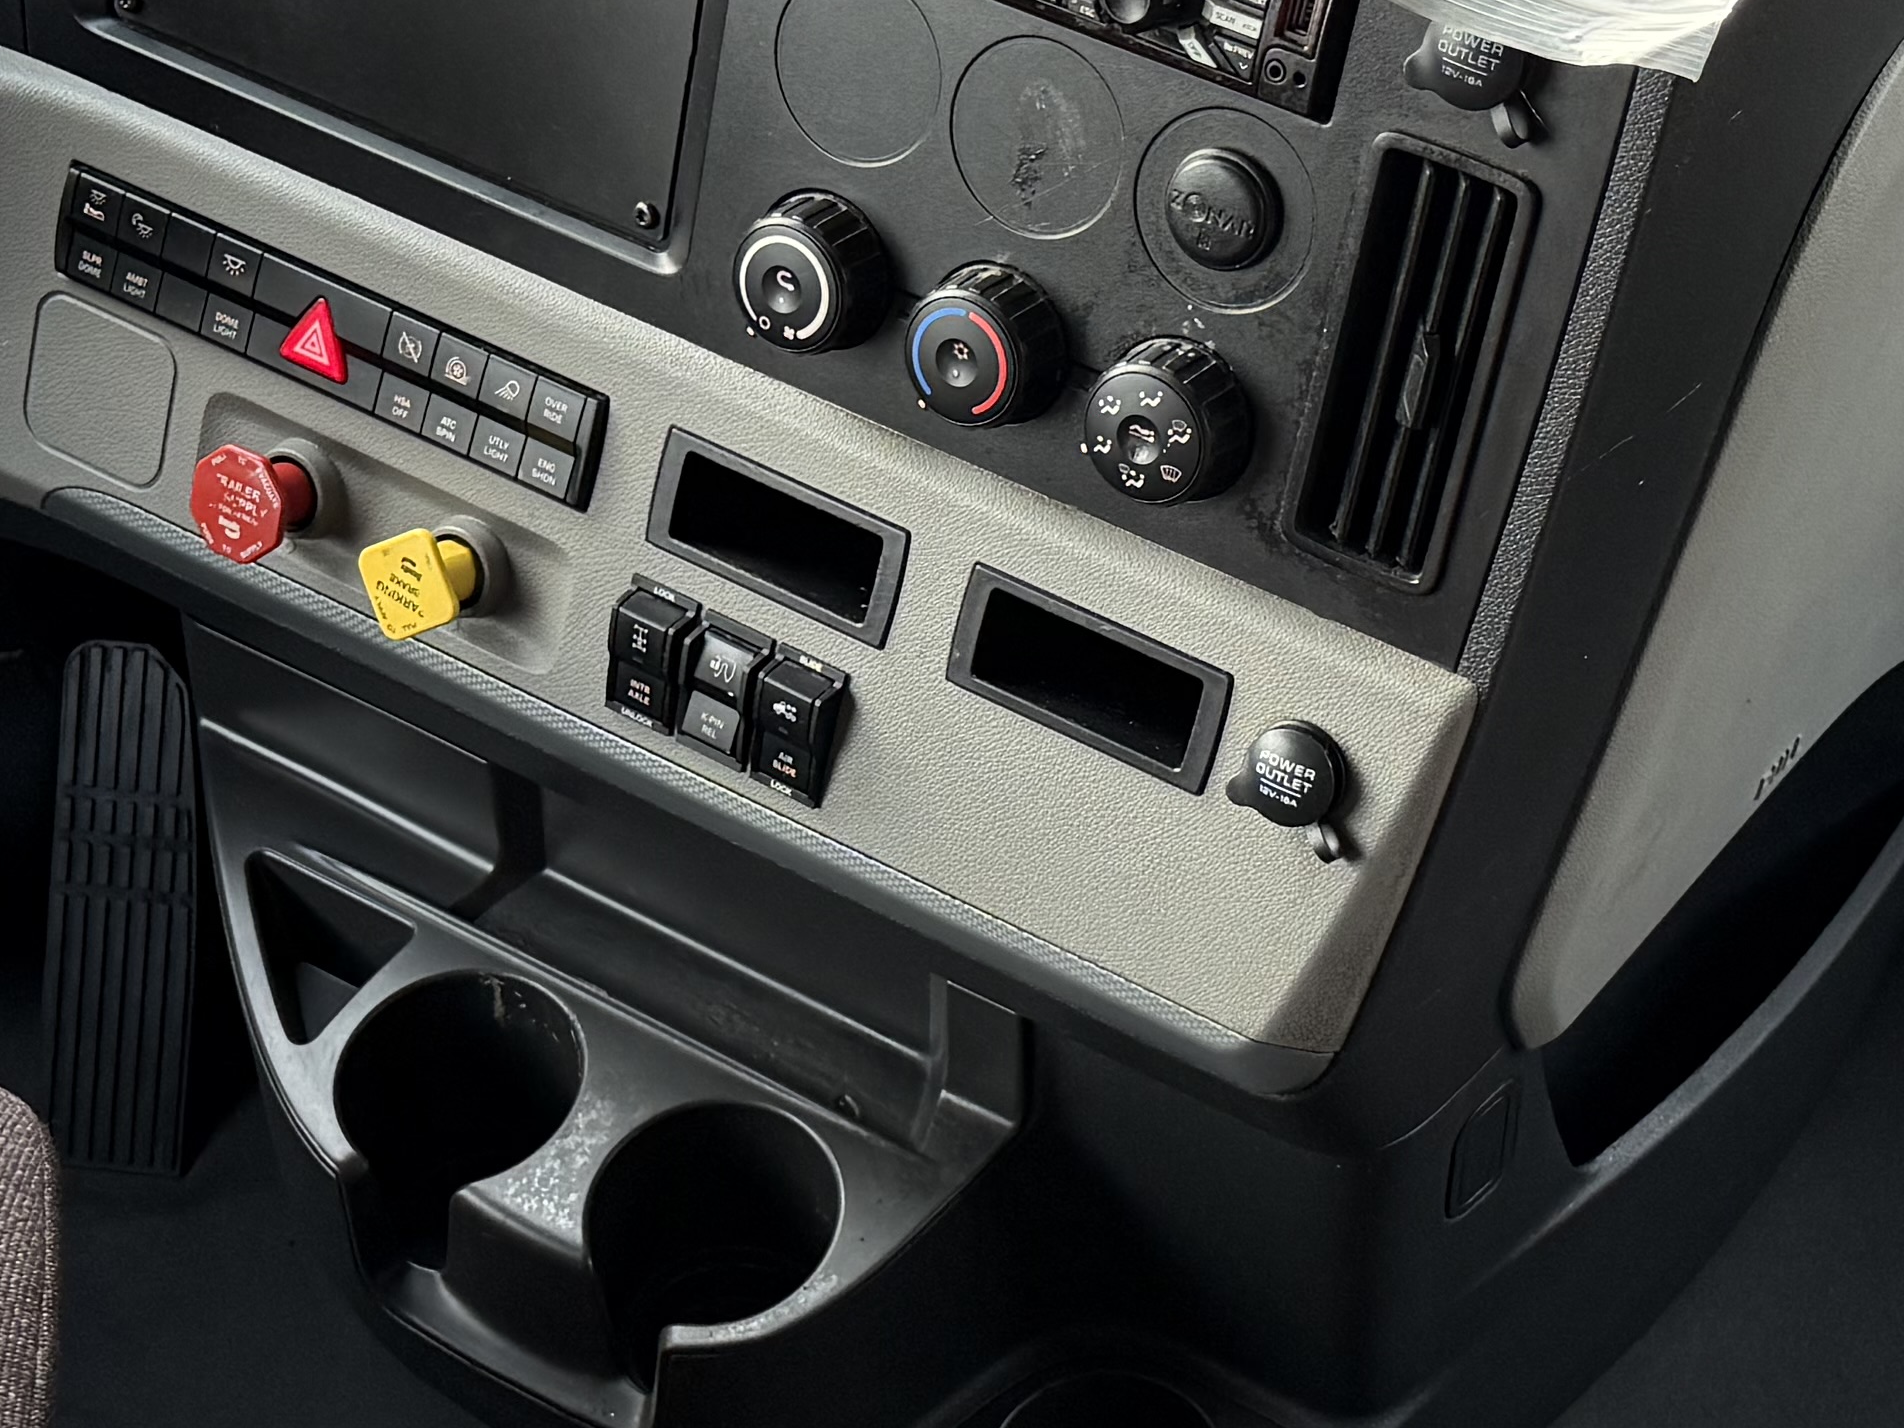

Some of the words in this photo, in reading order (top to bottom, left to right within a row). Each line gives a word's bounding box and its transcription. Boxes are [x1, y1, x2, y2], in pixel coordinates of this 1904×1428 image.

[1442, 24, 1504, 57] POWER
[1437, 39, 1501, 71] OUTLET
[545, 396, 569, 413] OVER
[488, 435, 510, 451] UTLY
[483, 446, 509, 464] LIGHT
[653, 586, 676, 603] LOCK
[621, 707, 653, 727] UNLOCK
[778, 751, 793, 765] AIR
[1259, 750, 1316, 781] POWER
[1256, 762, 1313, 794] OUTLET
[770, 779, 793, 796] LOCK
